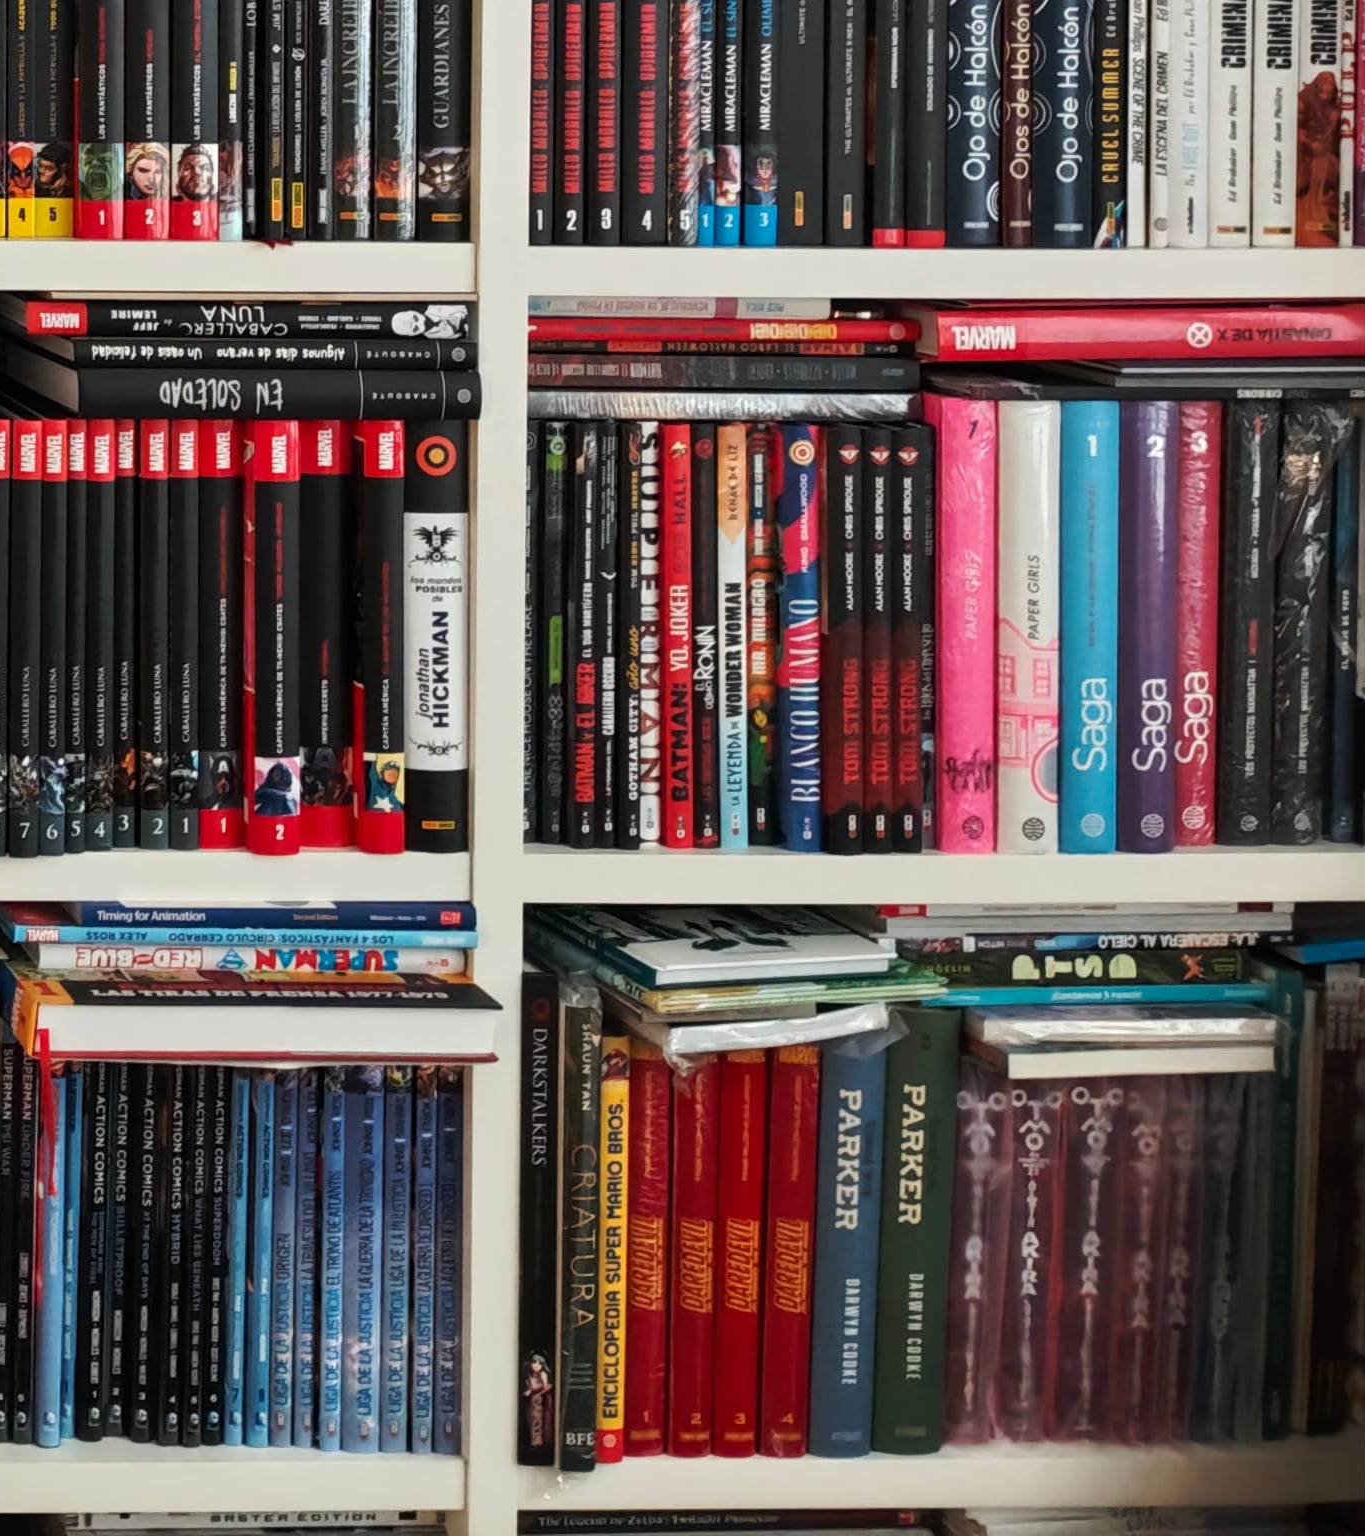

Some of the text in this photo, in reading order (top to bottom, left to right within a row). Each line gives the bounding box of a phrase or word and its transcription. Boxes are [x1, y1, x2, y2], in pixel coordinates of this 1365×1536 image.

[160, 378, 284, 411] EN SOLEDAD
[1028, 553, 1041, 641] PAPER GIRLS
[416, 647, 434, 719] jonathan
[432, 611, 450, 730] HICKMAN
[788, 598, 821, 804] BLANCO HUMANO
[1072, 677, 1112, 772] Saga
[97, 910, 206, 924] Timing for Animation
[530, 1027, 549, 1166] DARKSTALKERS
[836, 1088, 862, 1231] PARKER
[602, 1098, 624, 1419] ENCICLOPEDIA SUPER MARIO BROS.
[842, 1278, 860, 1385] DARWYN COOKE
